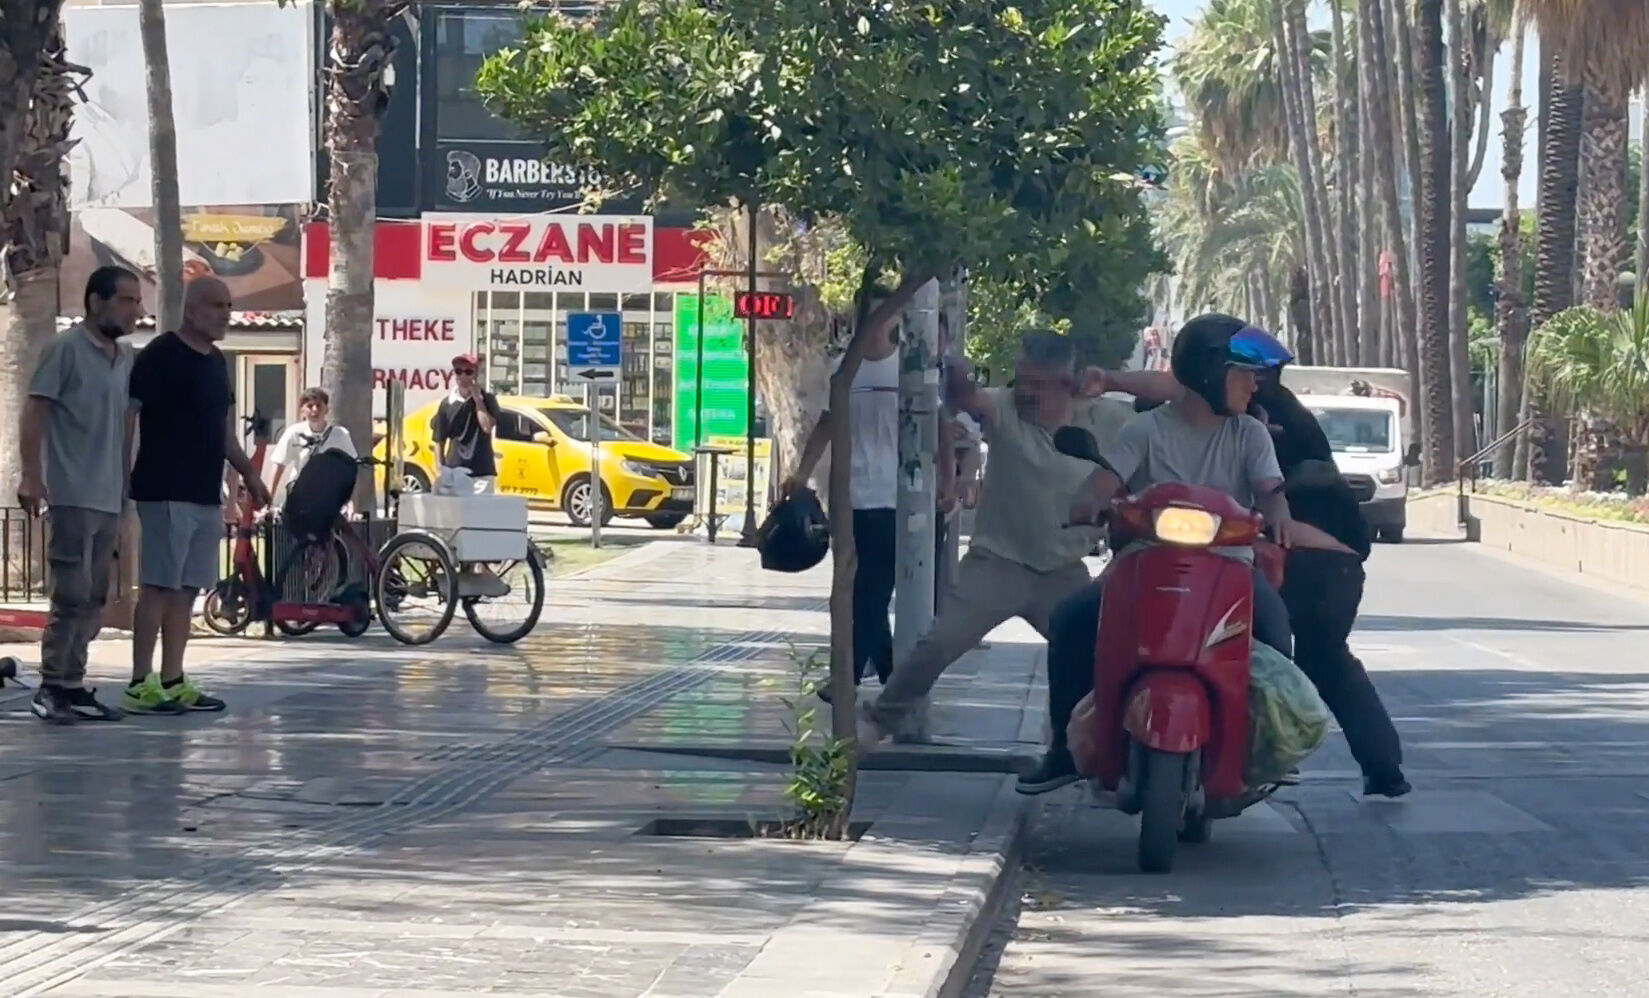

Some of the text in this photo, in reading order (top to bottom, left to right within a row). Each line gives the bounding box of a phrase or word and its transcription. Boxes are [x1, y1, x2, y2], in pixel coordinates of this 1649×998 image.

[427, 221, 646, 264] ECZANE
[490, 266, 583, 286] HADRİAN
[376, 319, 455, 341] THEKE
[372, 368, 454, 390] RMACY
